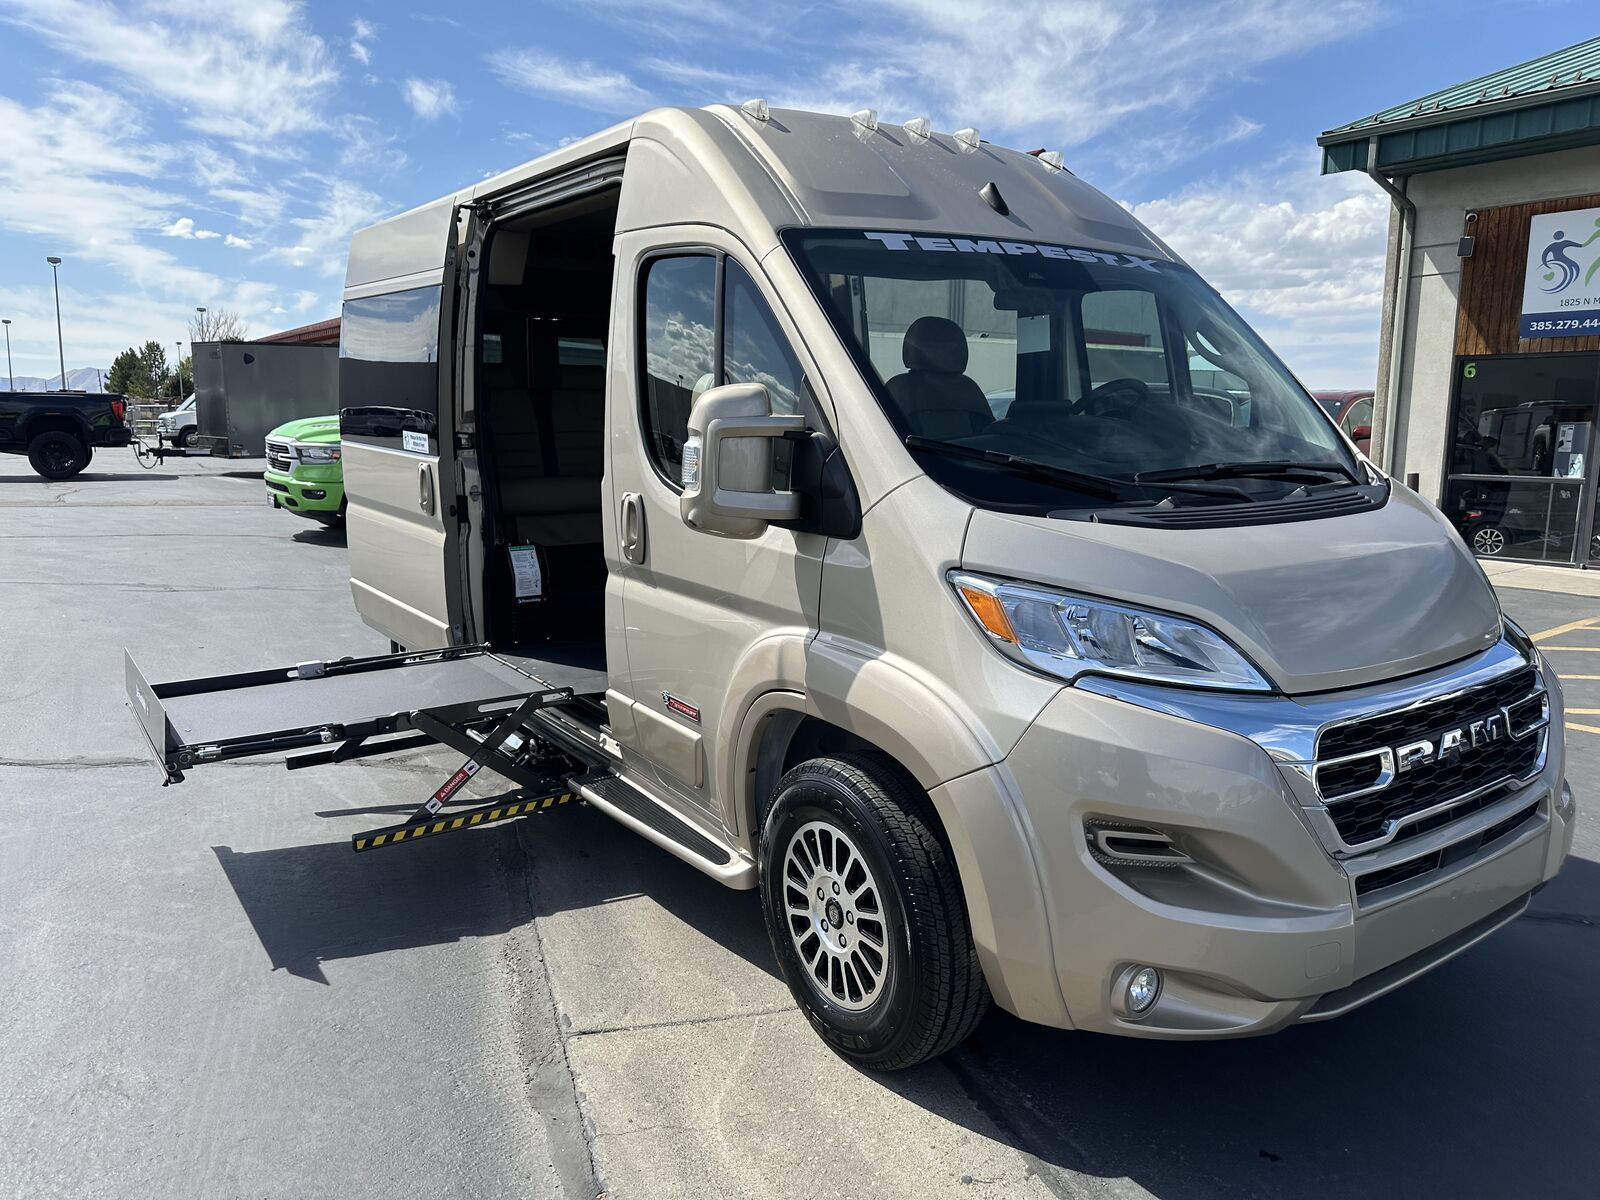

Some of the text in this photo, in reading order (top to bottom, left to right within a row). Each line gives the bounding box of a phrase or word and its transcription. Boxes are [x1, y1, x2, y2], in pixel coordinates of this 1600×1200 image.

[1560, 298, 1581, 307] 1825
[1583, 297, 1591, 305] N
[1529, 318, 1600, 331] 385.279.44
[1463, 362, 1477, 378] 6
[1396, 714, 1503, 773] RAM
[443, 773, 465, 793] DANGER
